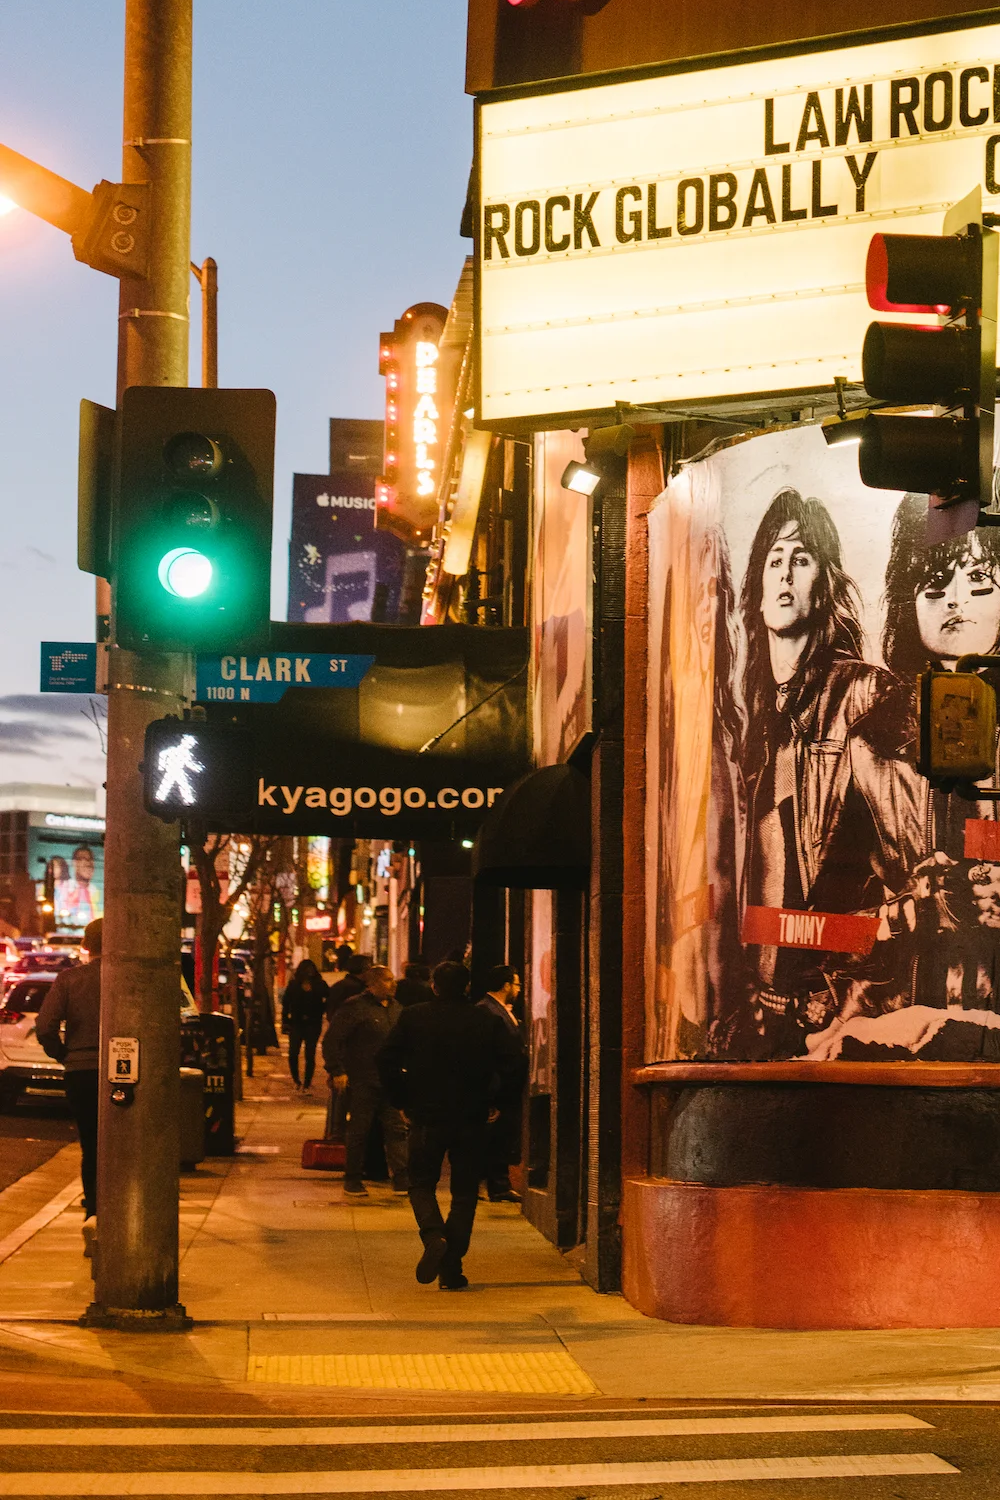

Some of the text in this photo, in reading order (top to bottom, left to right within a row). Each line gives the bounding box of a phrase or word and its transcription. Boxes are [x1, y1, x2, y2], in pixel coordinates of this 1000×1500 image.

[764, 83, 874, 157] LAW
[483, 191, 601, 262] ROCK
[615, 150, 879, 245] GLOBALLY
[331, 495, 377, 511] MUSIC
[220, 655, 348, 683] CLARK ST
[206, 686, 251, 701] 1100 N
[778, 912, 827, 947] TOMMY
